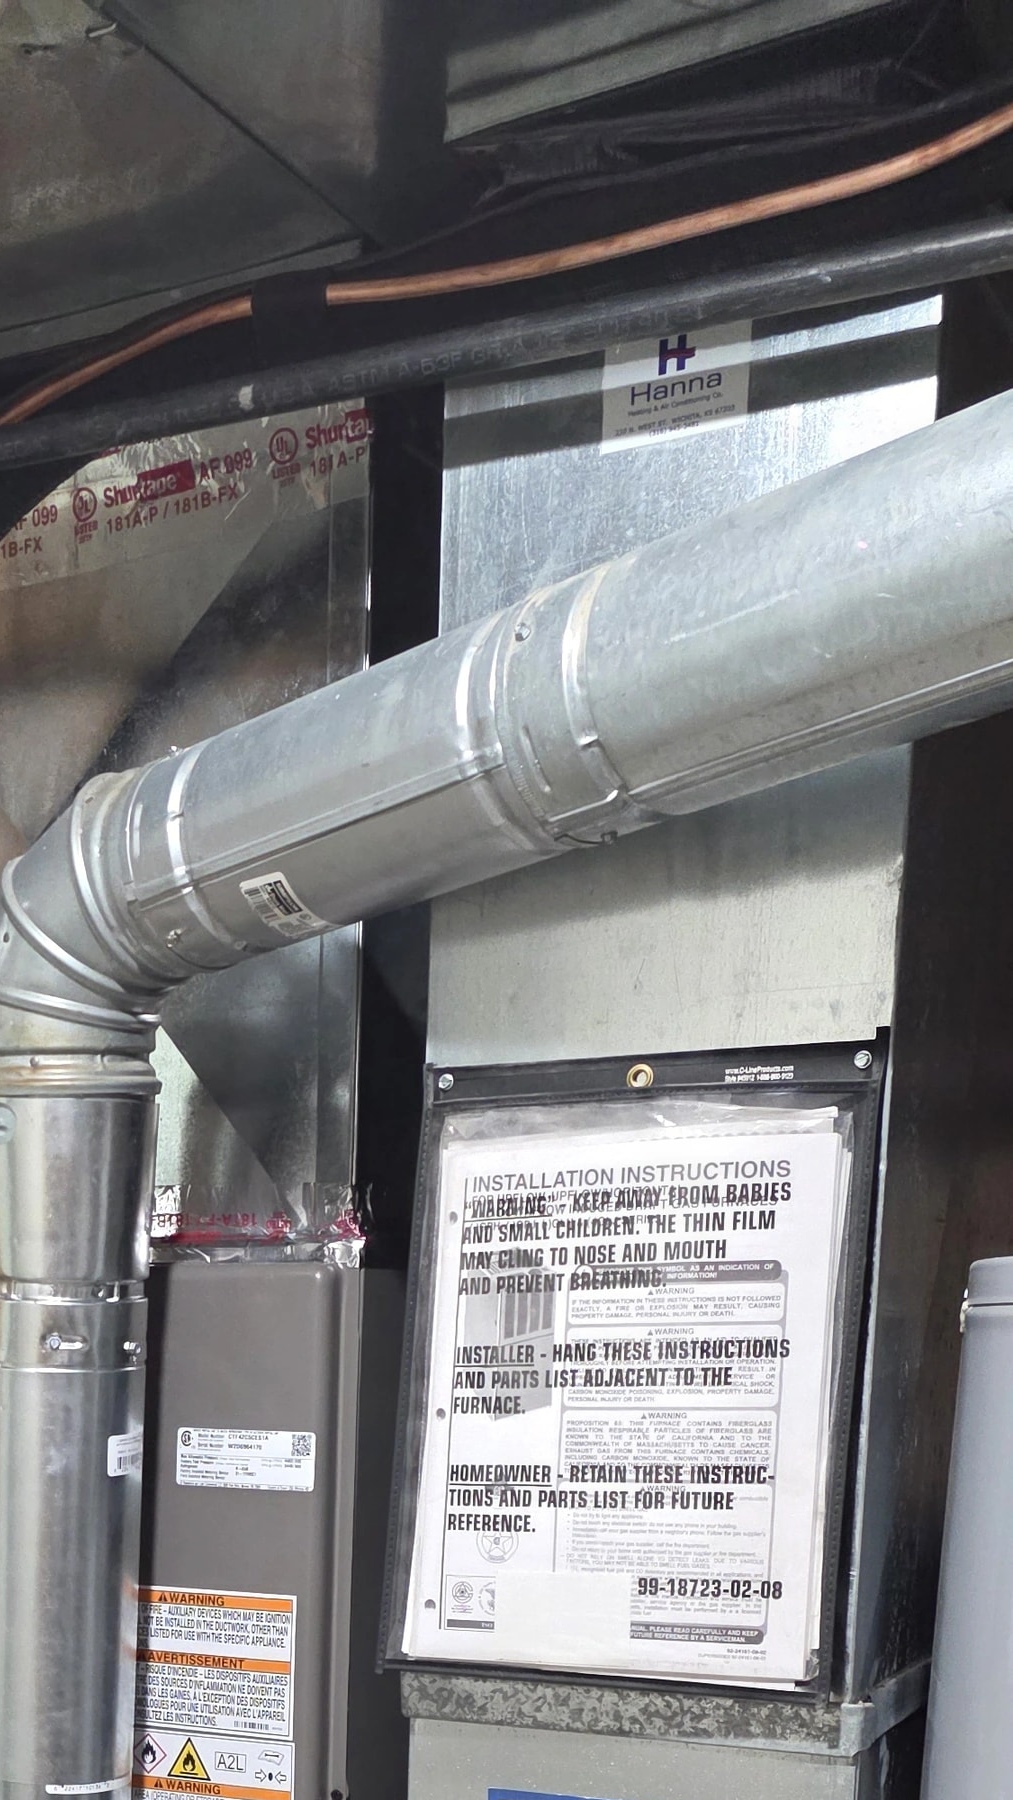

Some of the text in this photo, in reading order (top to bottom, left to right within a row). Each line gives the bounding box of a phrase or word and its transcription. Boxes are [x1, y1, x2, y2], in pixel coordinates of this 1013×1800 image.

[631, 373, 722, 405] Hanna
[104, 473, 178, 508] Shurtape
[199, 458, 220, 482] AF
[32, 504, 58, 527] 099
[106, 507, 158, 534] 181A-P
[174, 483, 240, 515] 181B-FX
[473, 1160, 791, 1195] INSTALLATION INSTRUCTIONS
[572, 1191, 609, 1211] KEEP
[614, 1187, 661, 1208] AWAY
[668, 1185, 718, 1206] FROM
[725, 1181, 791, 1203] BABIES
[462, 1209, 776, 1243] AND SMALL CHILDREN. THE THIN FILM
[461, 1238, 727, 1269] MAY CLING TO NOSE AND MOUTH
[459, 1269, 667, 1295] AND PREVENT BREATHING.
[654, 1286, 695, 1295] WARNING
[748, 1301, 781, 1309] CAUSING
[654, 1327, 694, 1336] WARNING
[456, 1337, 791, 1364] INSTALLER HANG THESE INSTRUCTIONS
[453, 1365, 733, 1390] AND PARTS LIST ADJACENT TO THE
[452, 1396, 526, 1414] FURNACE.
[449, 1464, 776, 1484] HOMEOWNER RETAIN THESE INSTRUC-
[448, 1489, 734, 1510] TIONS AND PARTS LIST FOR FUTURE
[446, 1514, 536, 1532] REFERENCE.
[169, 1593, 224, 1606] WARNING
[637, 1577, 784, 1601] 99-18723-02-08
[148, 1651, 244, 1669] AVERTISSEMENT
[217, 1754, 244, 1770] A2L
[165, 1779, 220, 1795] WARNING
